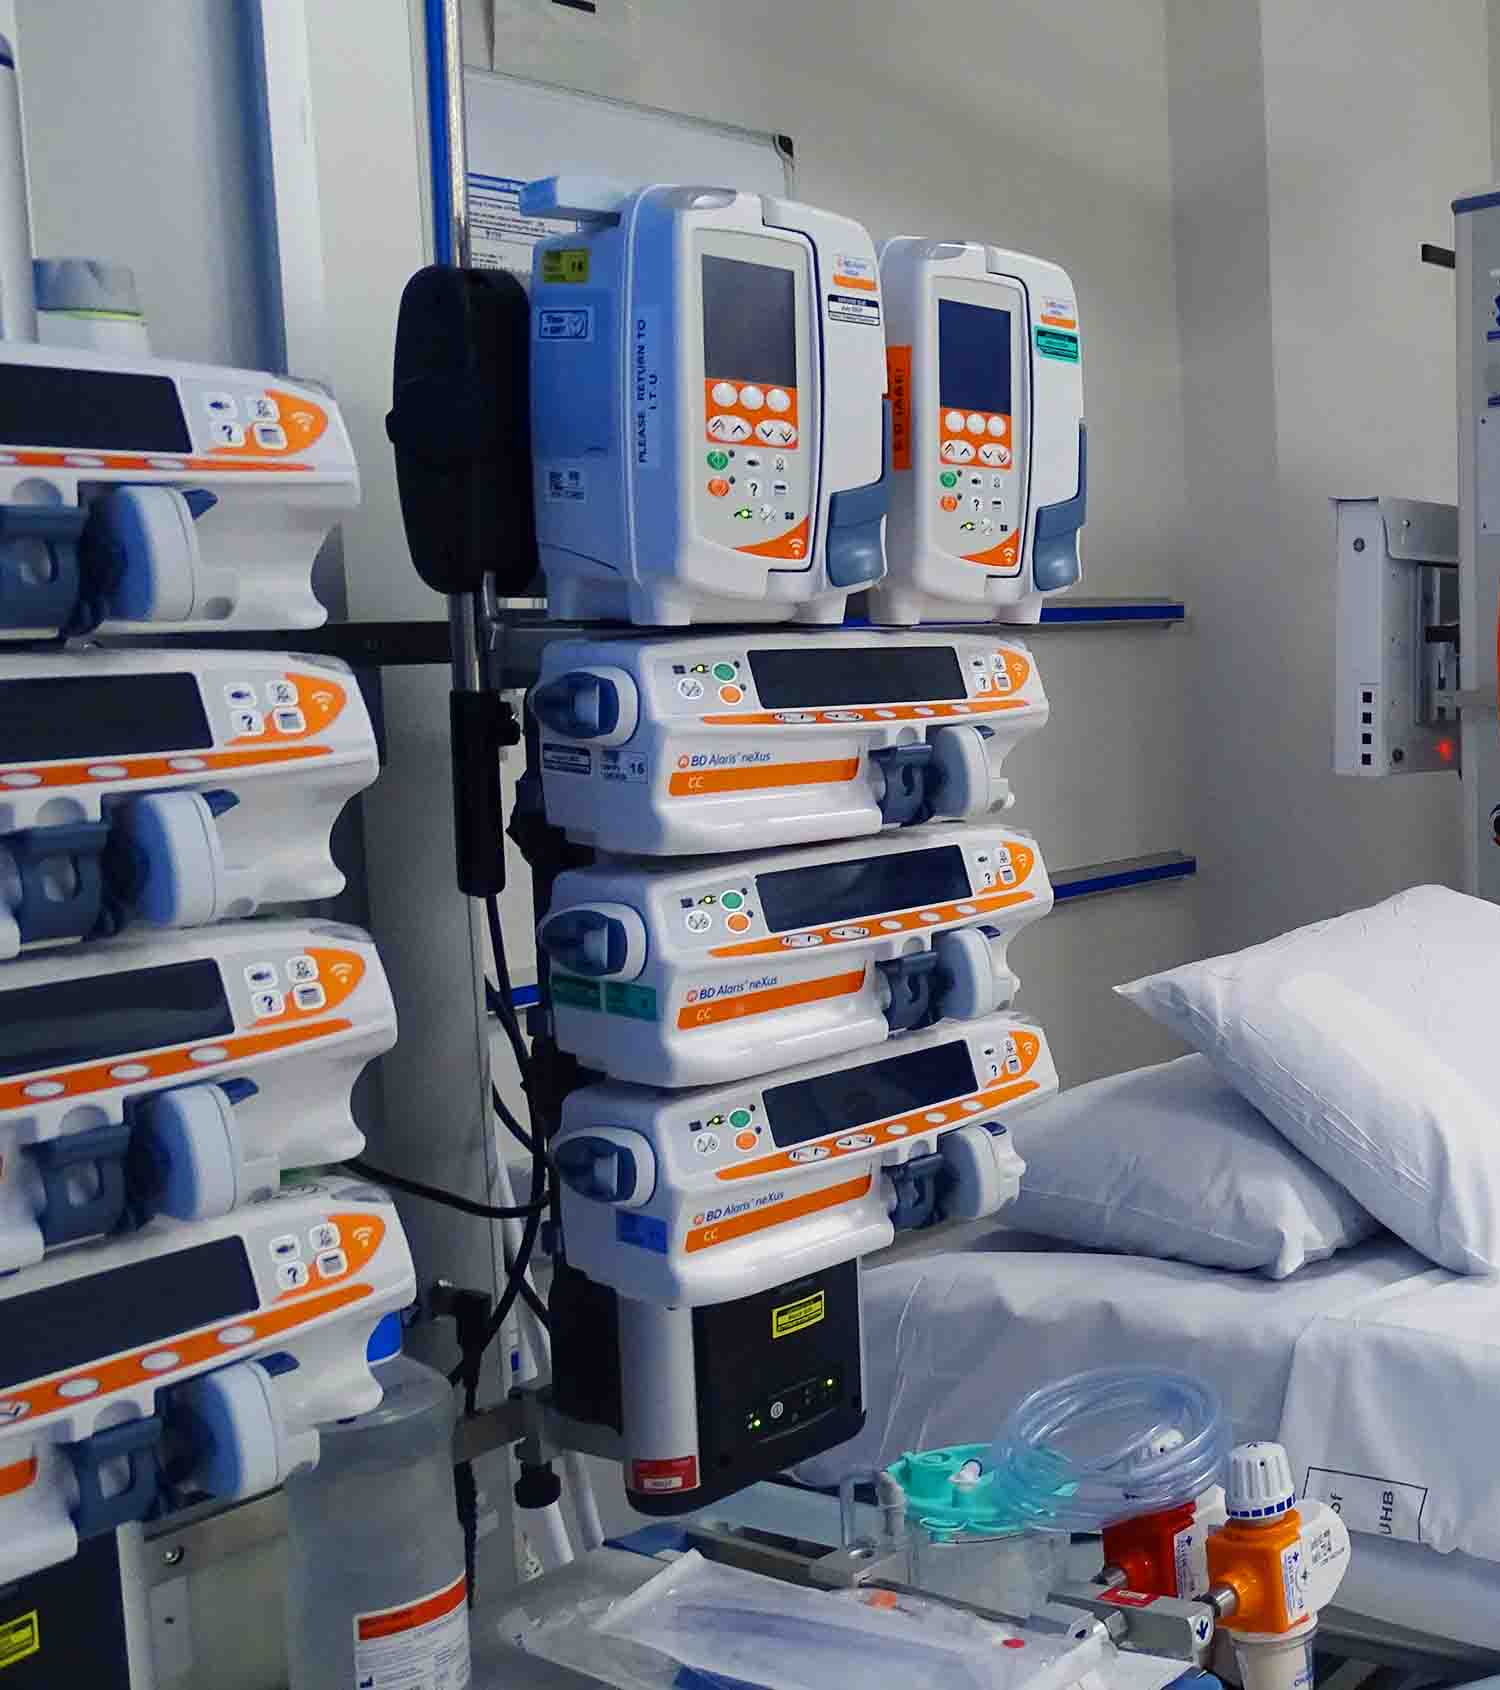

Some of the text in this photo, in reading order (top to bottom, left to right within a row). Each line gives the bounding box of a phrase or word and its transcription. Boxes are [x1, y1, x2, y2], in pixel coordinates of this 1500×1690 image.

[637, 319, 647, 463] PLEASE RETURN TO
[690, 755, 708, 767] BD
[688, 775, 705, 789] CC
[700, 989, 716, 1000] BD
[696, 1007, 712, 1021] CC
[706, 1208, 722, 1223] BD
[703, 1228, 718, 1241] CC
[1379, 1490, 1395, 1535] UHB
